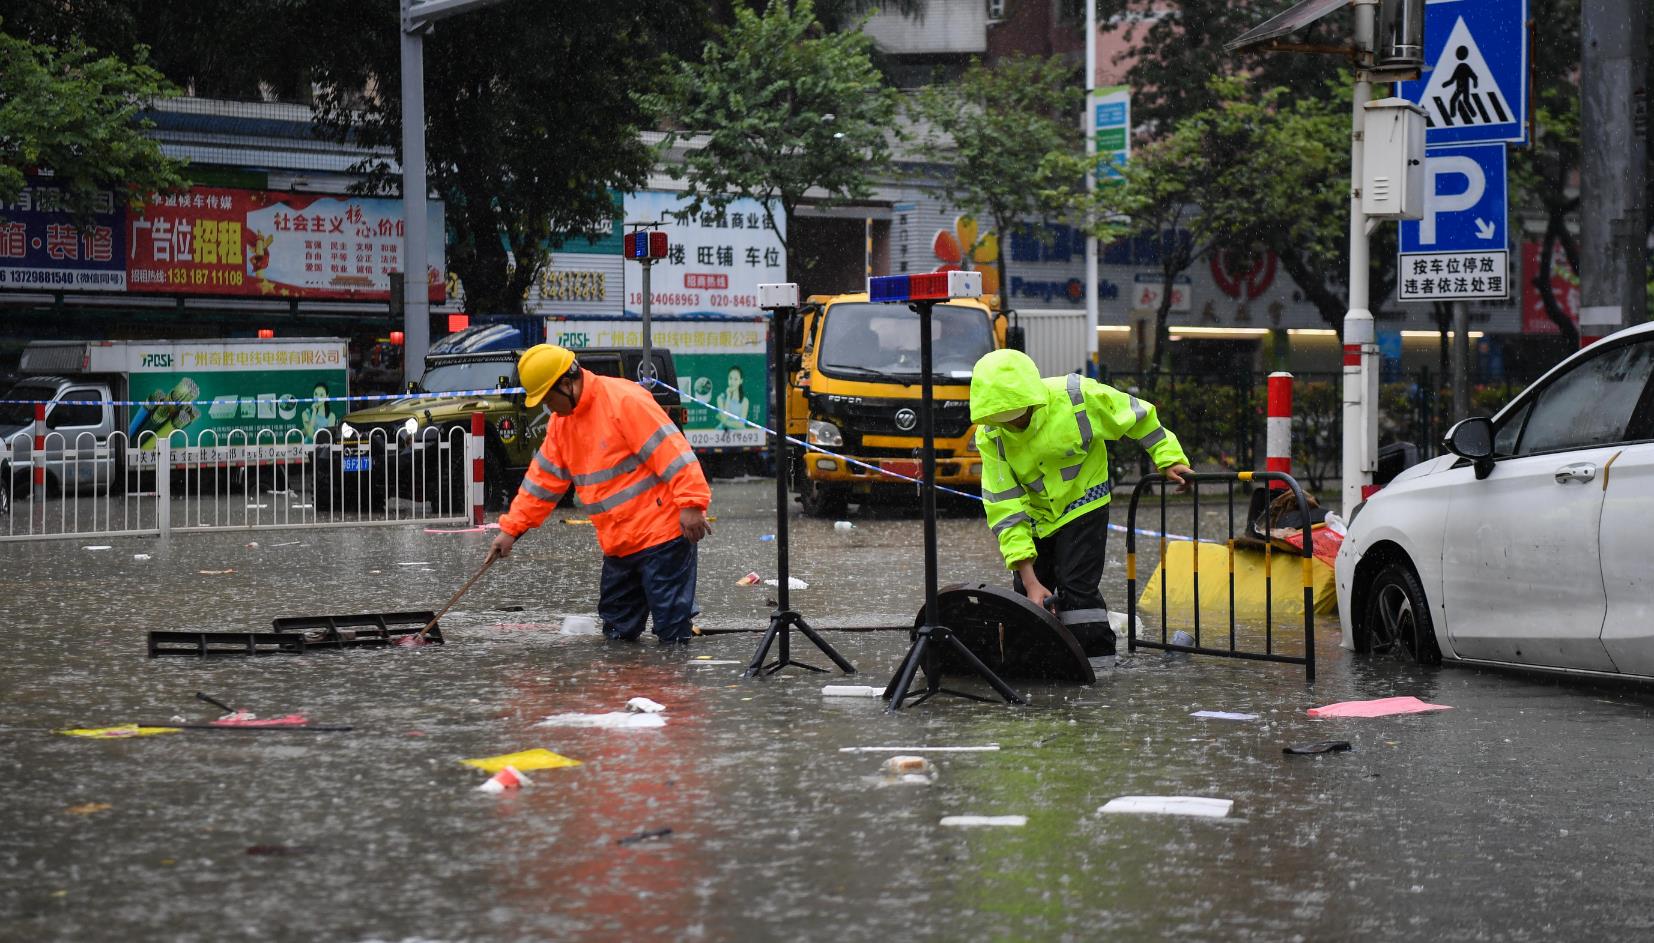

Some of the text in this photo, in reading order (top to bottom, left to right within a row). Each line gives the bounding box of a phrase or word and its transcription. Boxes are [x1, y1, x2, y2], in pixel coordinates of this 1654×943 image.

[1419, 155, 1486, 245] P
[131, 216, 243, 265] 广告位招租
[331, 241, 348, 250] 民主
[356, 243, 373, 253] 文明
[305, 253, 322, 262] 自由
[331, 253, 348, 263] 平等
[356, 255, 373, 264] 公正
[697, 245, 734, 267] 旺铺
[745, 246, 780, 268] 车位
[1413, 257, 1494, 275] 按车位停放
[10, 271, 73, 283] 13729881540
[168, 268, 187, 284] 133
[190, 269, 209, 284] 187
[211, 270, 243, 286] 11108
[1404, 276, 1503, 294] 违者依法处理
[630, 293, 757, 307] 1824068963 020-8461
